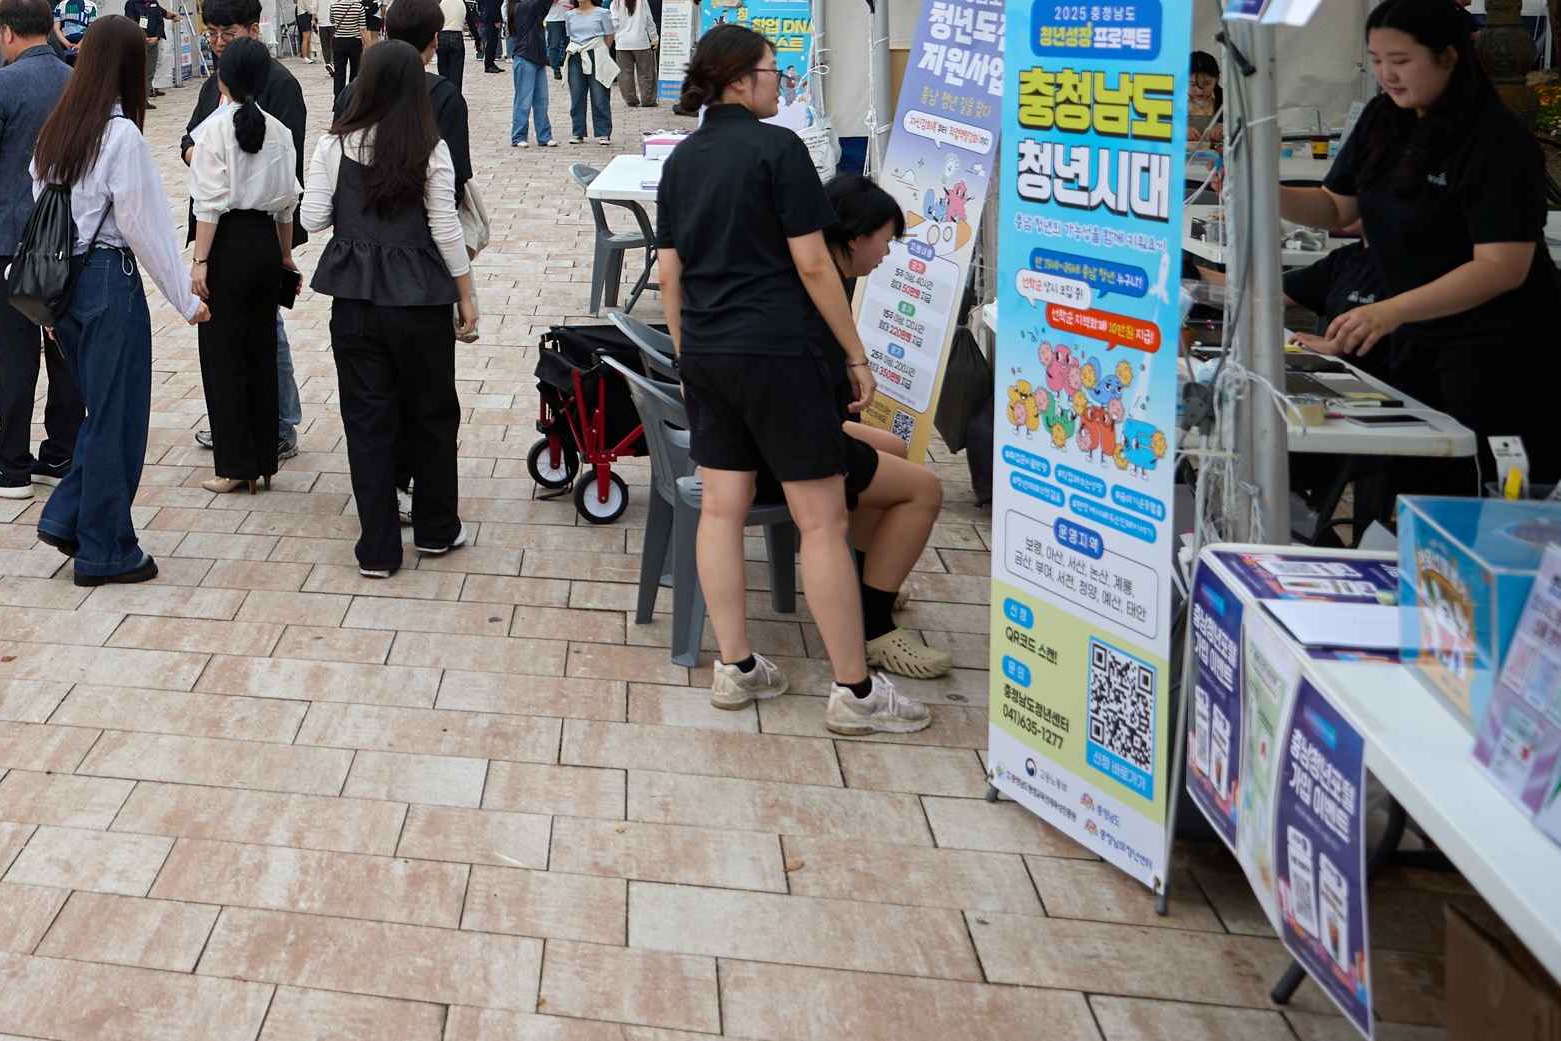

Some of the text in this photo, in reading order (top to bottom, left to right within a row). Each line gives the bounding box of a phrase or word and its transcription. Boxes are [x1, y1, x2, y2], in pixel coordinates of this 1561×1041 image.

[1054, 6, 1136, 21] 2025 충청남도
[1093, 27, 1152, 50] 프로젝트
[1018, 65, 1175, 143] 충청남도
[1017, 137, 1171, 224] 청년시대
[1057, 523, 1099, 554] 운영지역
[1126, 600, 1147, 623] 태안
[1004, 625, 1036, 654] QR코드
[1002, 683, 1070, 734] 충청남도청년센터
